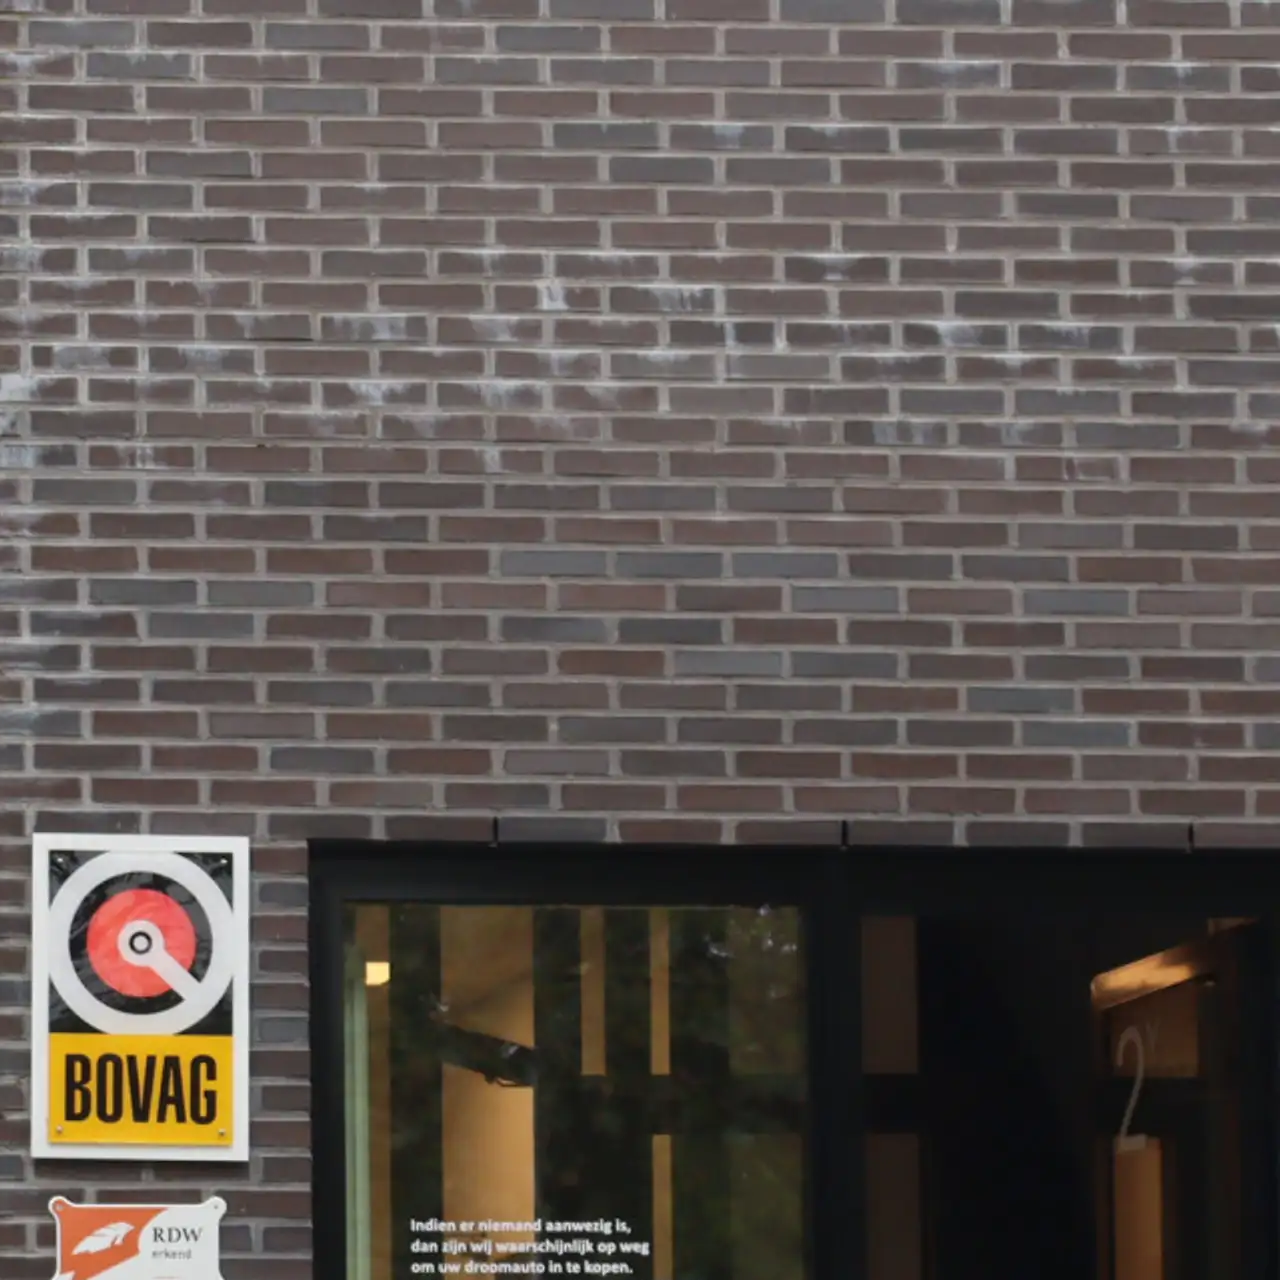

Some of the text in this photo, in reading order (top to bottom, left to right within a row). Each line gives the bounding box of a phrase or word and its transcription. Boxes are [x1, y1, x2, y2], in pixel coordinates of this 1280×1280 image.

[64, 1053, 218, 1125] BOVAG
[410, 1218, 632, 1234] Indien er niemand aanwezig is,
[152, 1227, 202, 1243] RDW
[151, 1248, 192, 1260] erkend
[410, 1239, 650, 1255] dan zijn wij waarschijnlijk op weg
[410, 1260, 633, 1276] om uw droomauto in te kopen.
